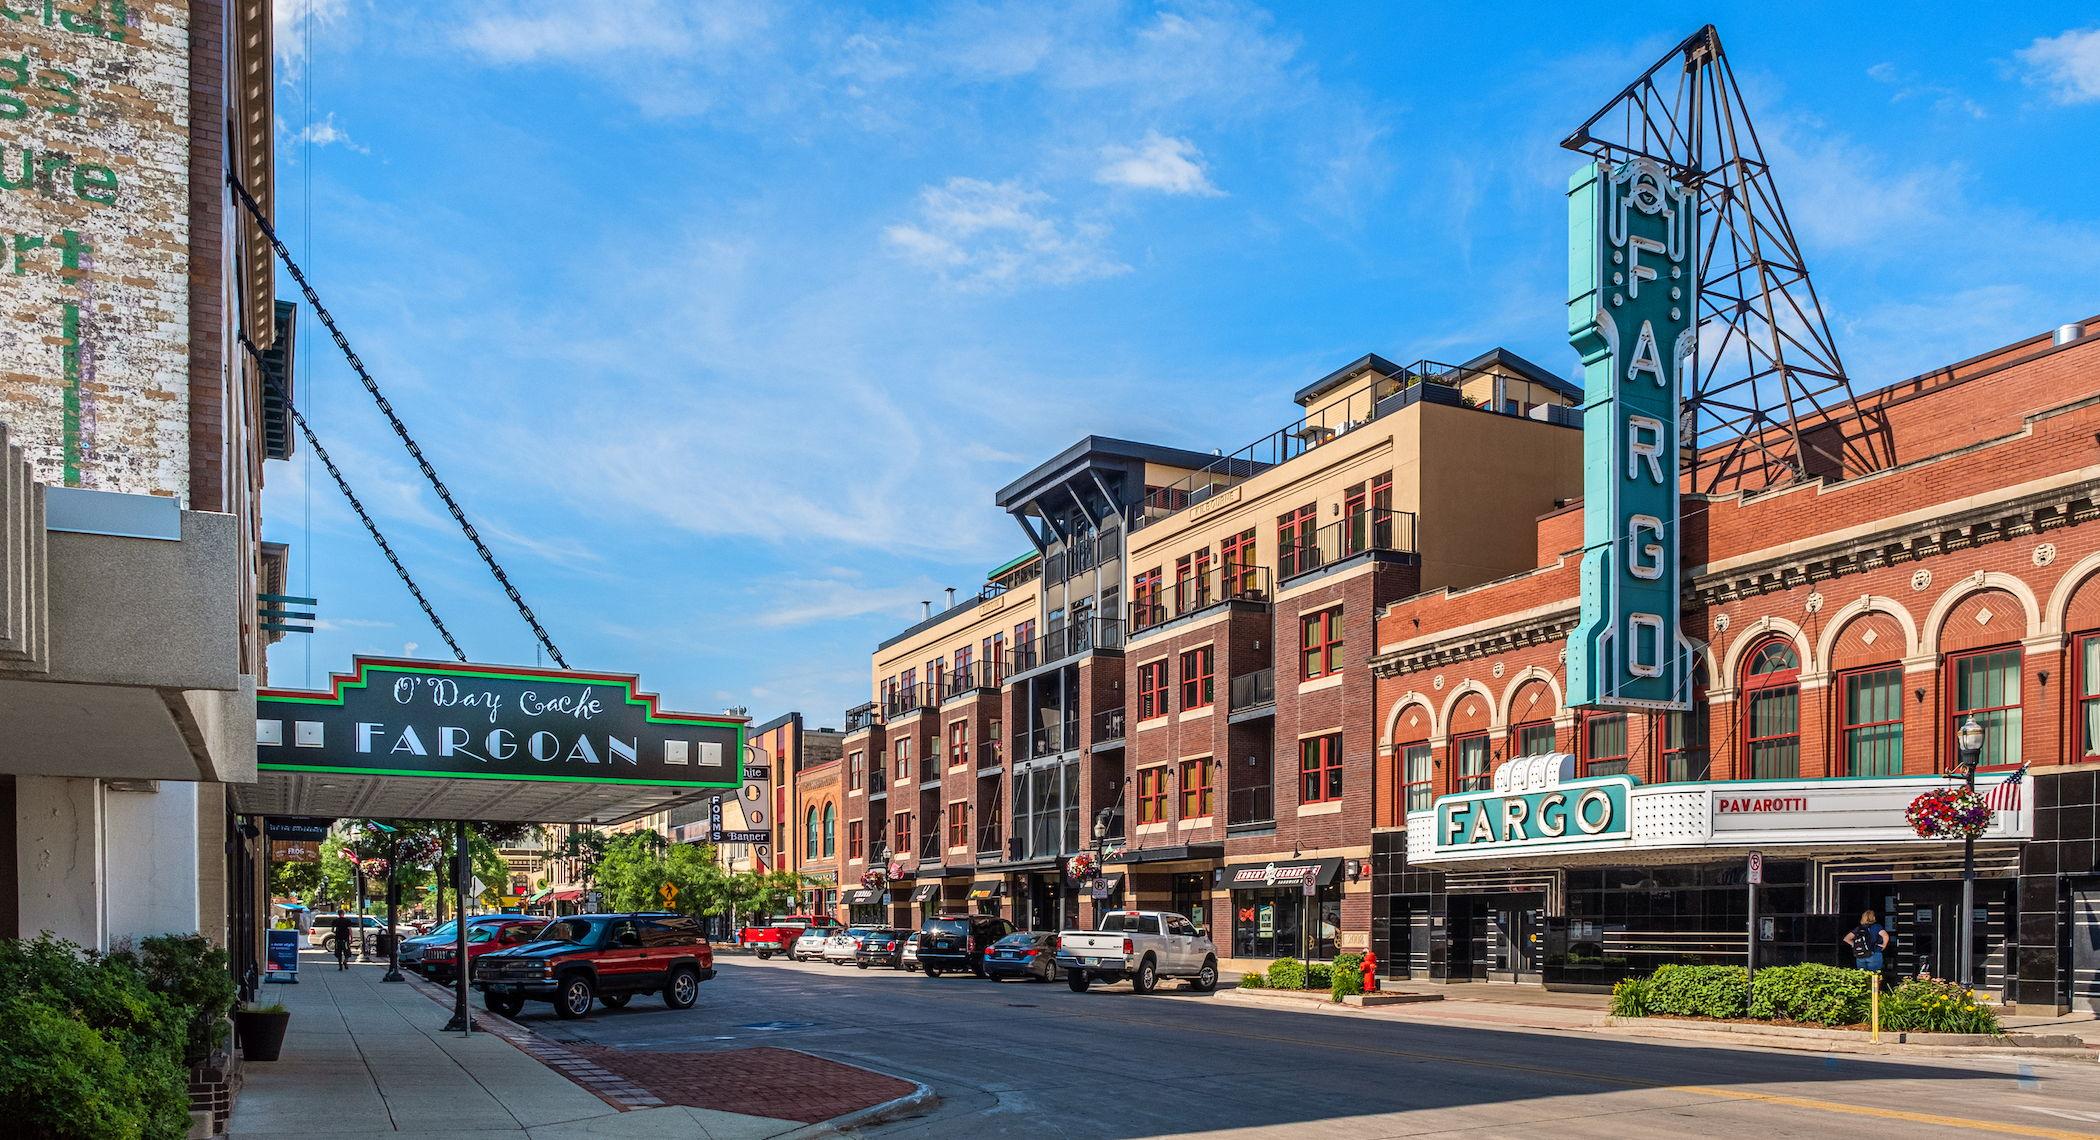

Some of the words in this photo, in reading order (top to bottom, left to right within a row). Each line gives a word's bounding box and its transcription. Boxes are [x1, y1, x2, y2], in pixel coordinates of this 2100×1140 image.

[1627, 234, 1666, 679] FARGO
[393, 676, 502, 723] O'Day
[519, 686, 604, 720] Cache
[355, 722, 638, 766] FARGOAN
[743, 767, 762, 778] hite
[712, 796, 721, 840] FORMS
[1446, 787, 1613, 846] FARGO
[1719, 798, 1807, 813] PAVAROTTI
[727, 831, 767, 842] Banner
